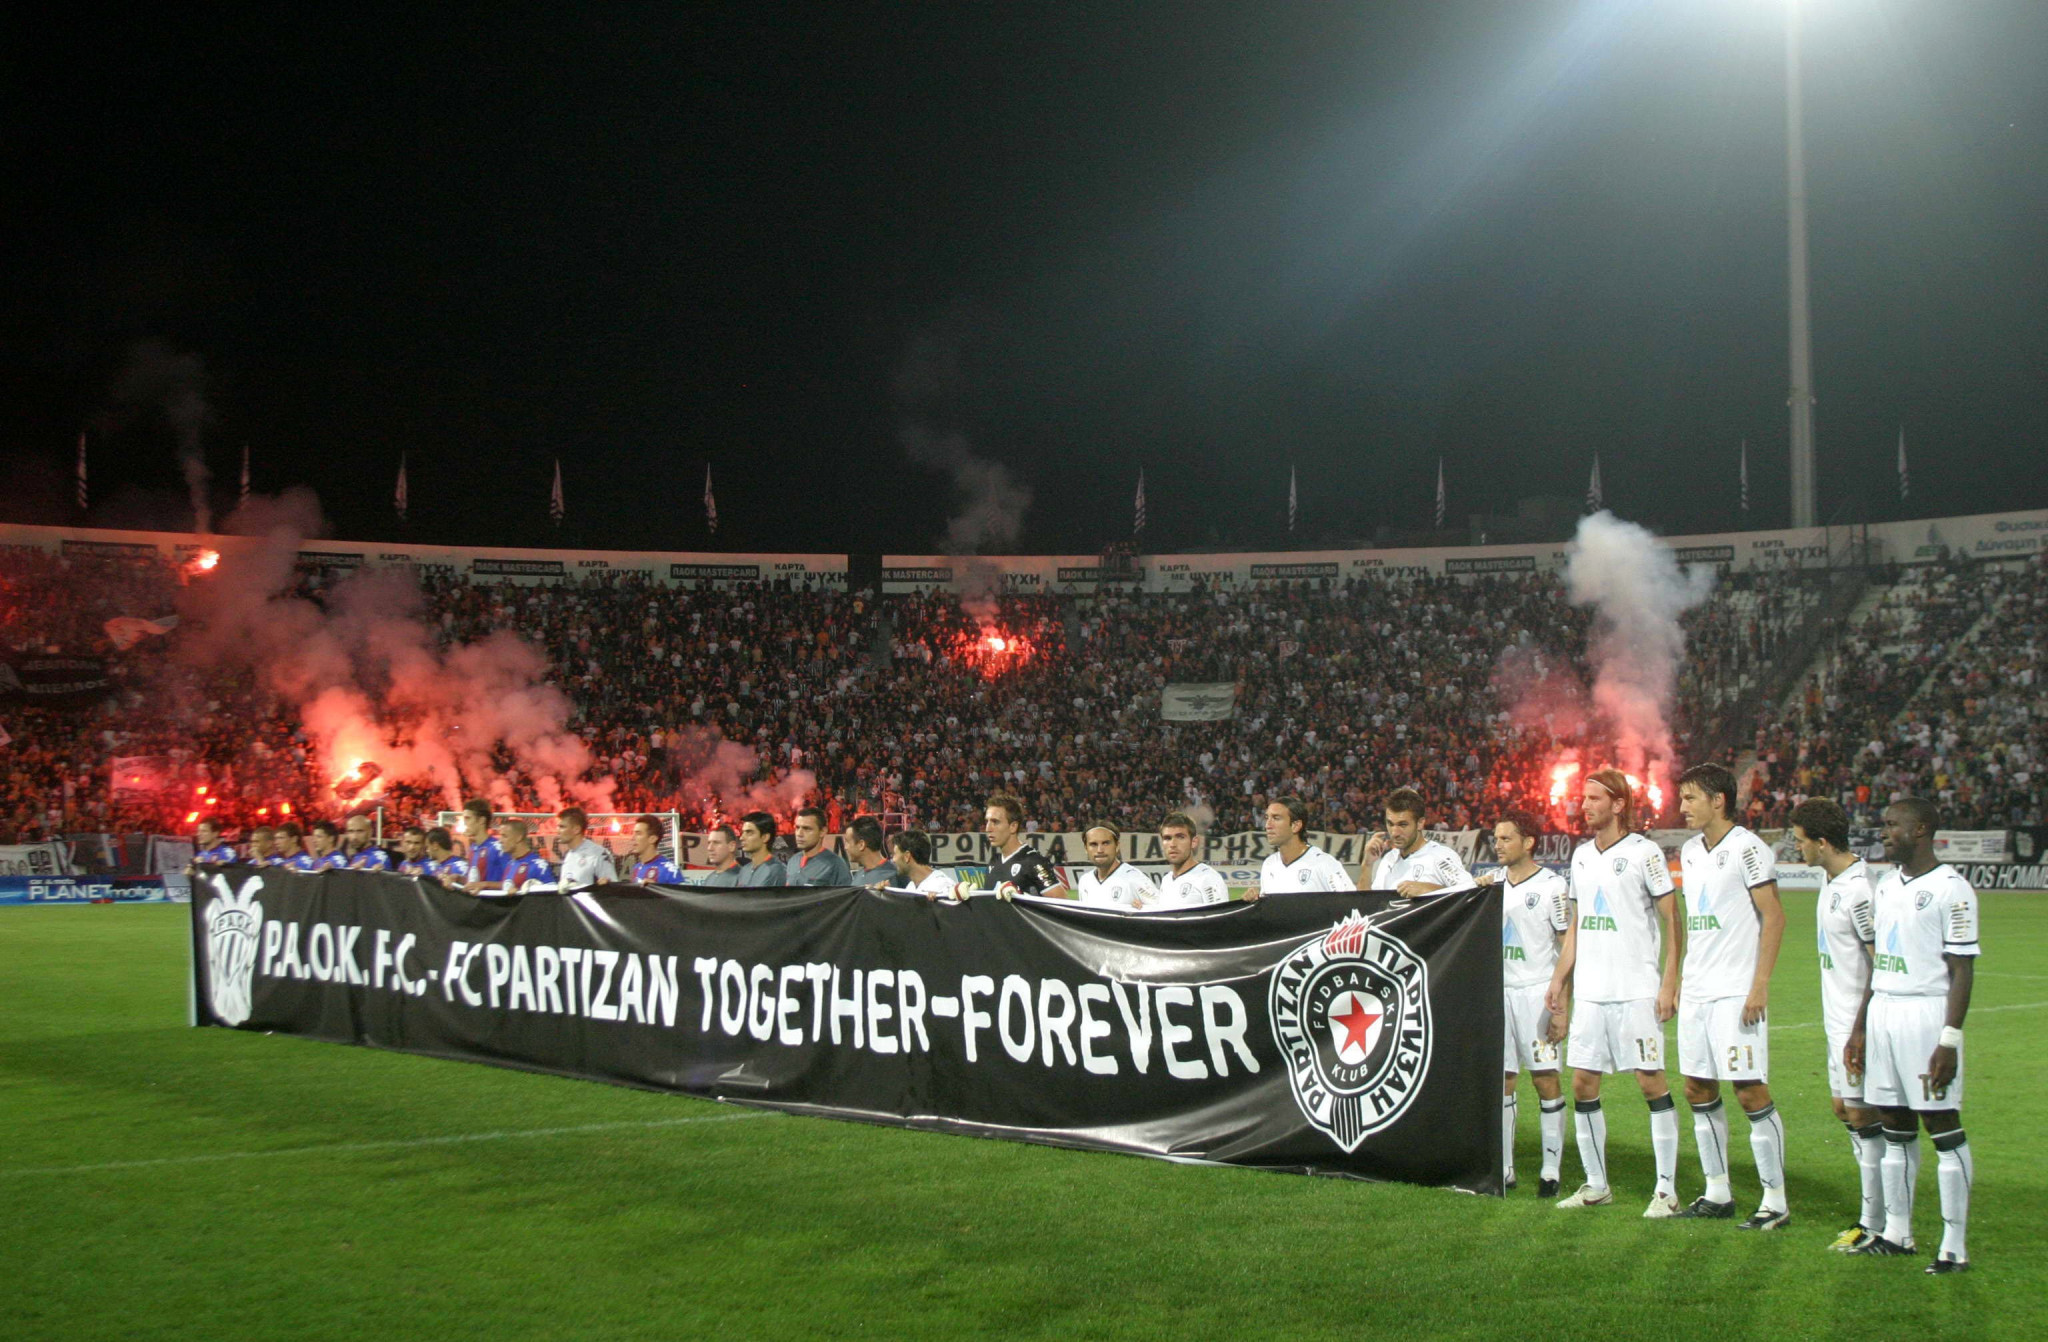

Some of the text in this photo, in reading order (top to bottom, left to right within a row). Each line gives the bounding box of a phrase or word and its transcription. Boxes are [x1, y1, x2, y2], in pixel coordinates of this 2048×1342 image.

[699, 568, 758, 578] MASTERCARD
[774, 563, 806, 571] ΚΑΡΤΑ
[1278, 565, 1337, 576] MASTERCARD
[30, 884, 112, 900] PLANET
[261, 920, 369, 986] P.A.O.K.
[486, 944, 679, 1028] PARTIZAN
[1313, 972, 1396, 1030] FUDBALSKI
[1276, 948, 1326, 1114] PARTIZAN
[1636, 1037, 1659, 1063] 13
[1727, 1044, 1753, 1072] 21
[1331, 1064, 1369, 1083] KLUB
